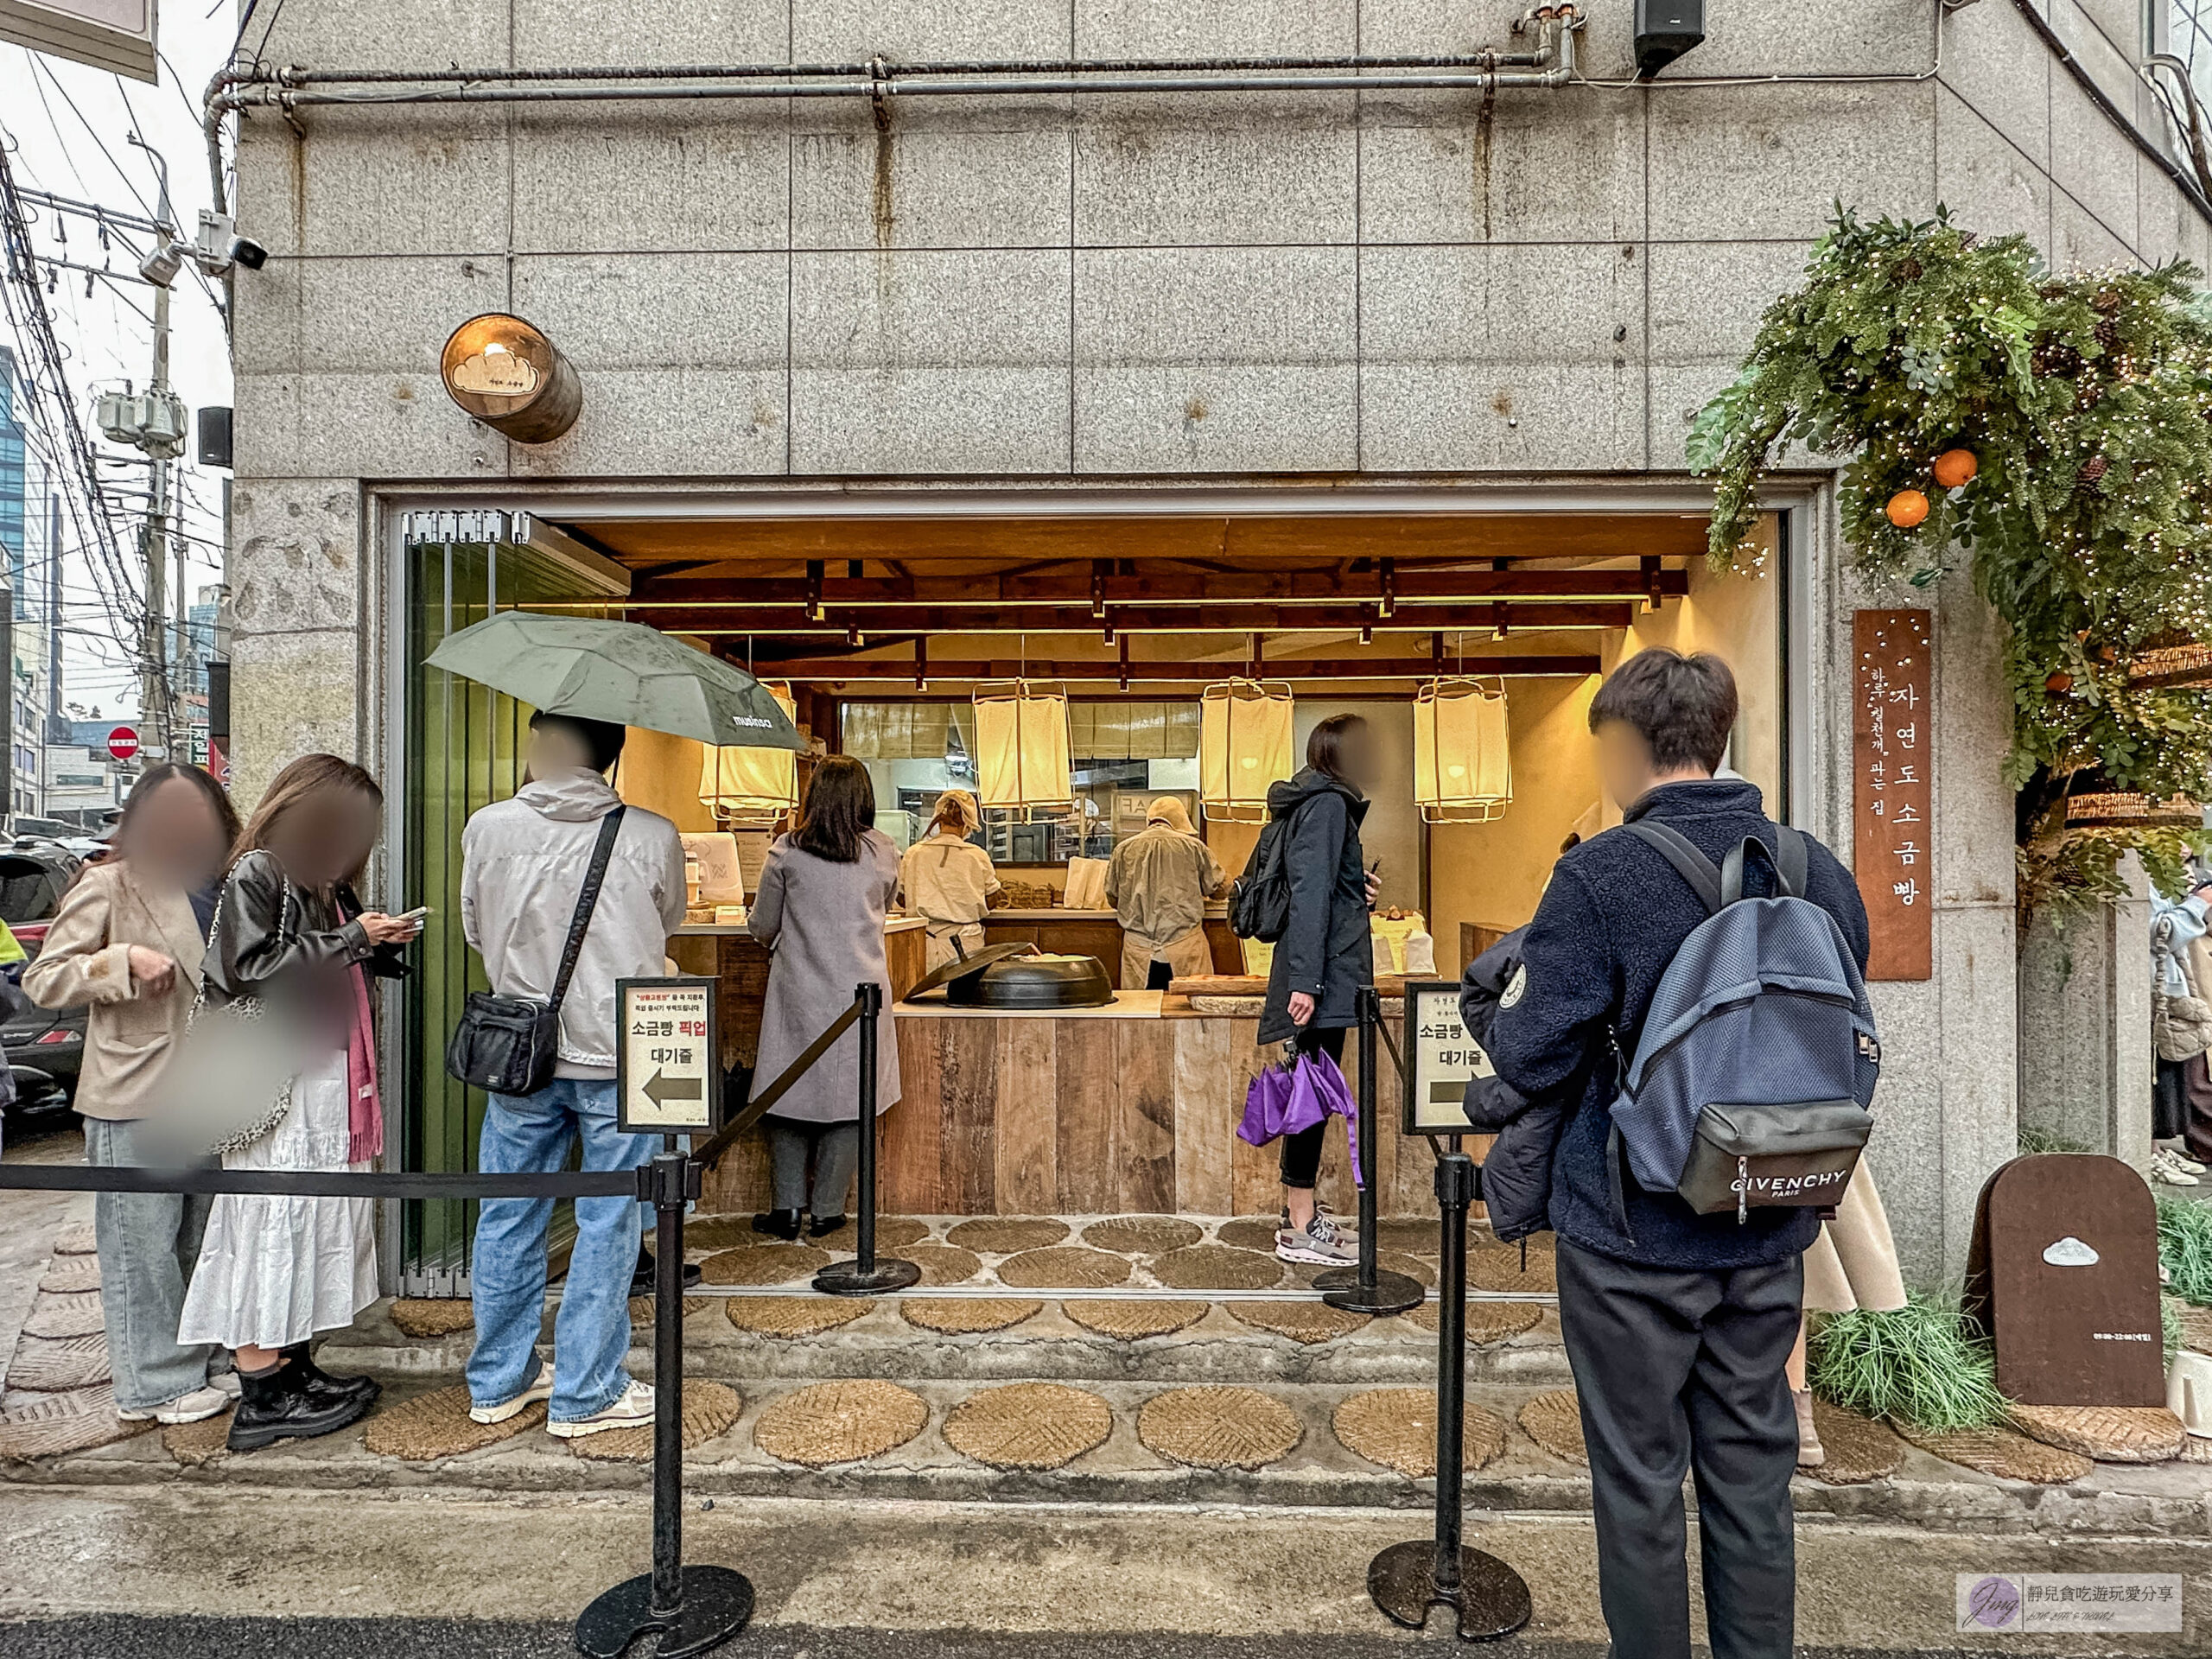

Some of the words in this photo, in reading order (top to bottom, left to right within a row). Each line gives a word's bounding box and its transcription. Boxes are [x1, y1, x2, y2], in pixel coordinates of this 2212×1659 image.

[1871, 667, 1885, 698] 하루
[732, 715, 773, 728] musinsa
[1870, 760, 1886, 791] 파는
[1870, 799, 1885, 816] 집
[632, 1020, 674, 1036] 소금빵
[679, 1020, 706, 1037] 픽업
[1420, 1024, 1463, 1039] 소금빵
[651, 1048, 693, 1065] 대기줄
[1440, 1050, 1482, 1065] 대기줄
[1730, 1170, 1847, 1192] GIVENCHY
